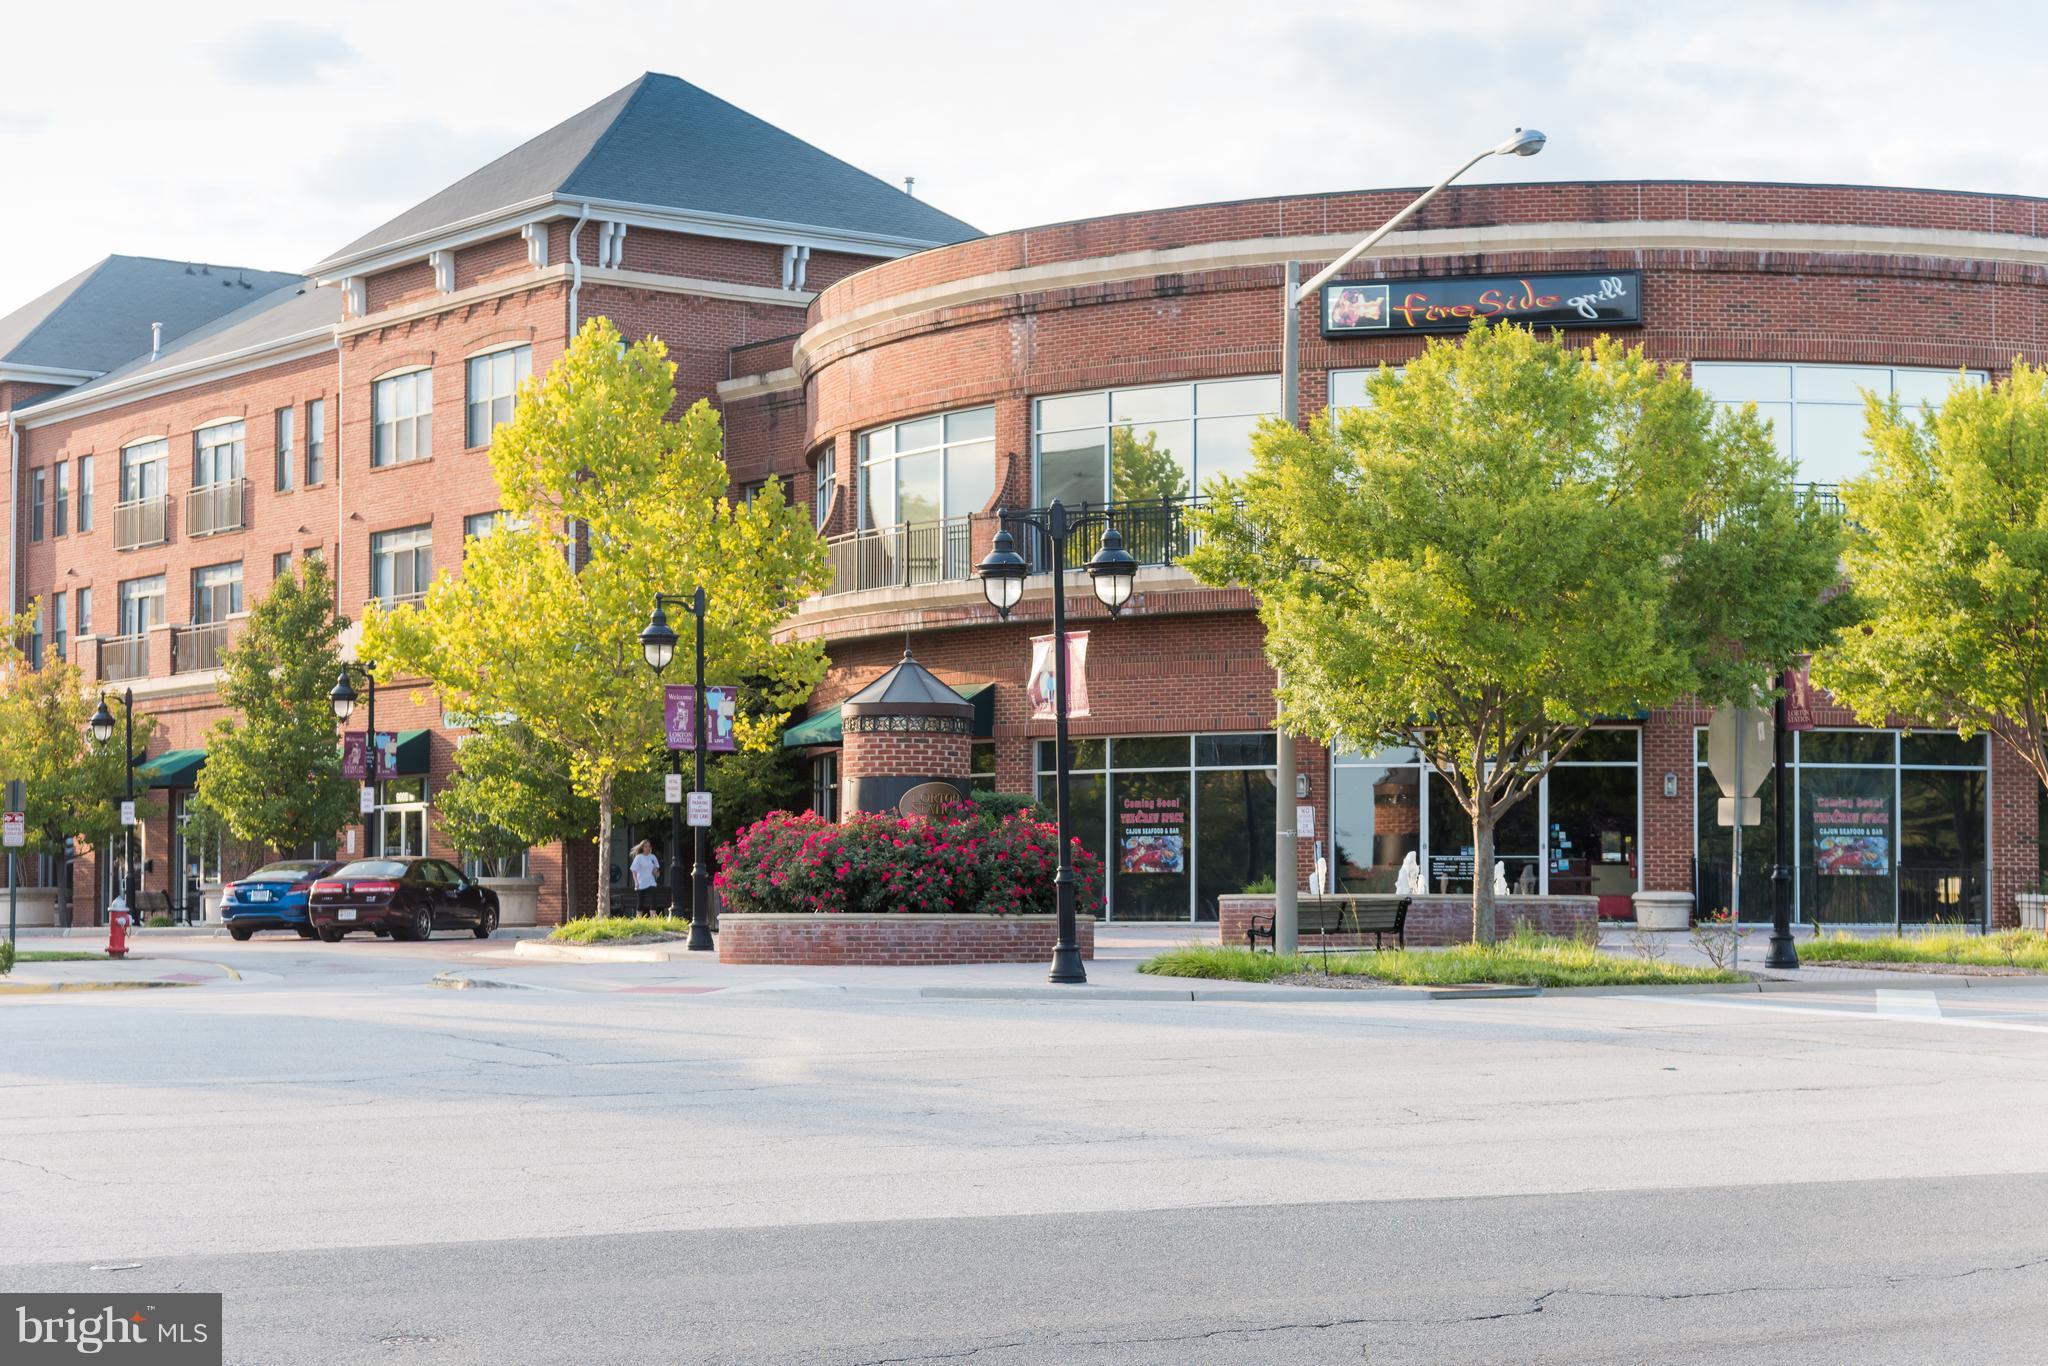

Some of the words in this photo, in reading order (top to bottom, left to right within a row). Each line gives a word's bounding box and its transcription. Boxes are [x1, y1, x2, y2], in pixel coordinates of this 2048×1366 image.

[1567, 277, 1627, 319] grill
[1124, 798, 1155, 809] Coming
[1156, 798, 1180, 808] Soon!
[1817, 796, 1854, 809] Coming
[1856, 796, 1884, 808] Soon!
[1125, 827, 1142, 835] CAJUN
[1142, 827, 1164, 835] SEAFOOD
[1819, 827, 1839, 835] CAJUN
[1839, 827, 1865, 835] SEAFOOD
[1871, 827, 1884, 835] BAR
